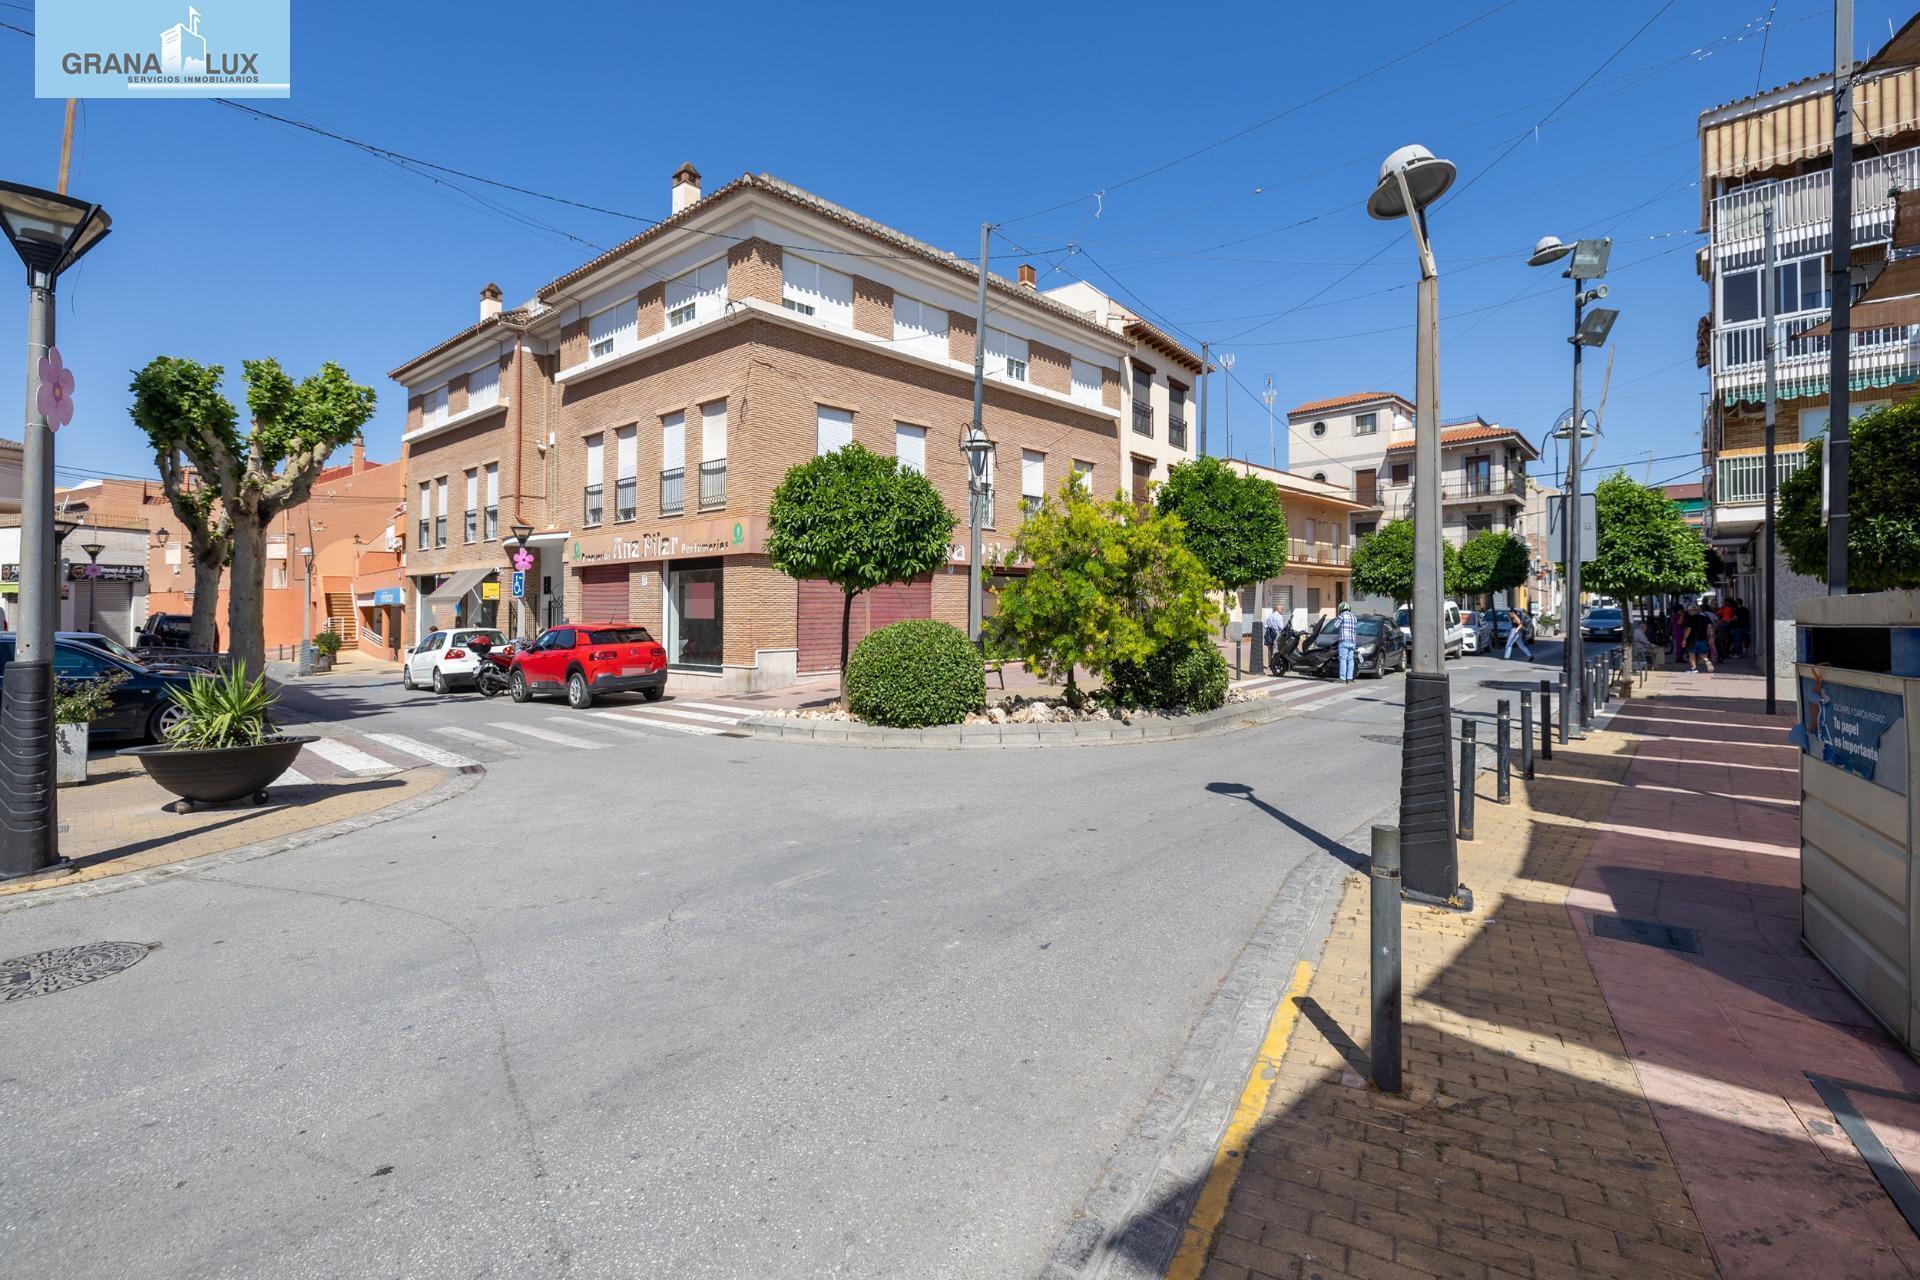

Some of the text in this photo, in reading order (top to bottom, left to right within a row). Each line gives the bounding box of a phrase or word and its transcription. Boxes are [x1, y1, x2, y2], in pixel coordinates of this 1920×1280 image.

[613, 537, 640, 560] Ana
[643, 531, 679, 558] Pilar
[1833, 716, 1859, 736] Tu papel
[1834, 736, 1879, 761] es importante
